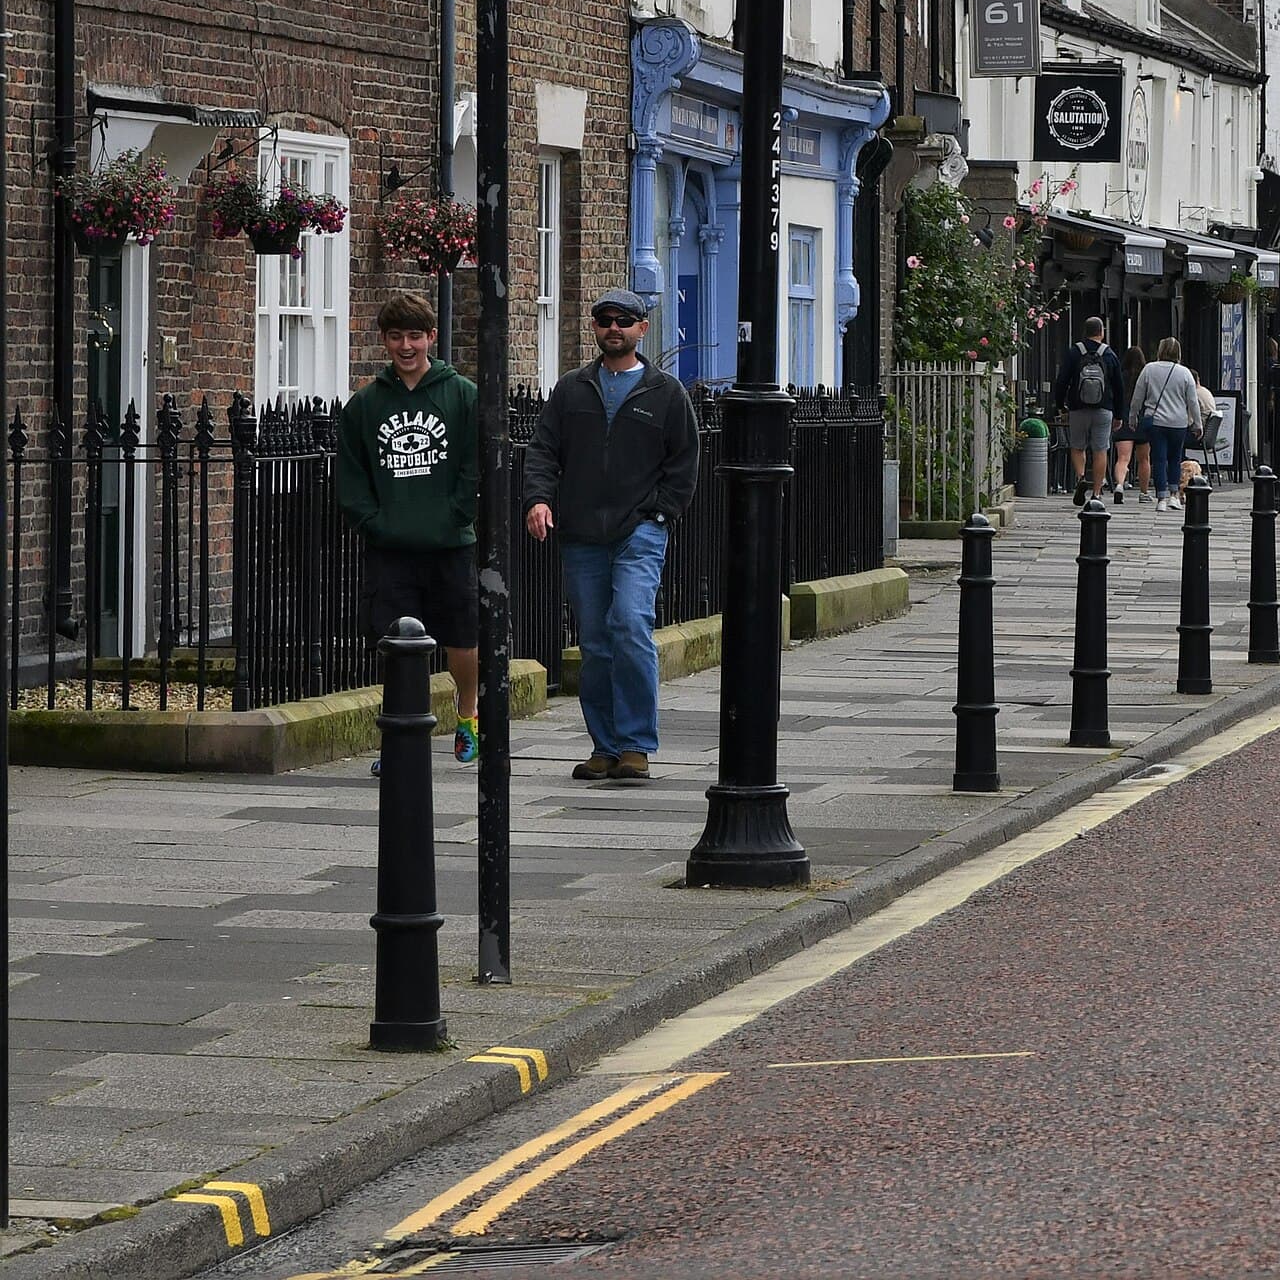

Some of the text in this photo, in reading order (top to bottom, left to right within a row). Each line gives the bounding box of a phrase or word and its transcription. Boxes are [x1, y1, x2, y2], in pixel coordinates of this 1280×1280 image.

[985, 2, 1024, 24] 61
[1053, 111, 1102, 124] SALUTATION
[770, 111, 781, 251] 24F379
[377, 410, 446, 444] IRELAND
[420, 438, 429, 446] 22
[386, 449, 438, 469] REPUBLIC
